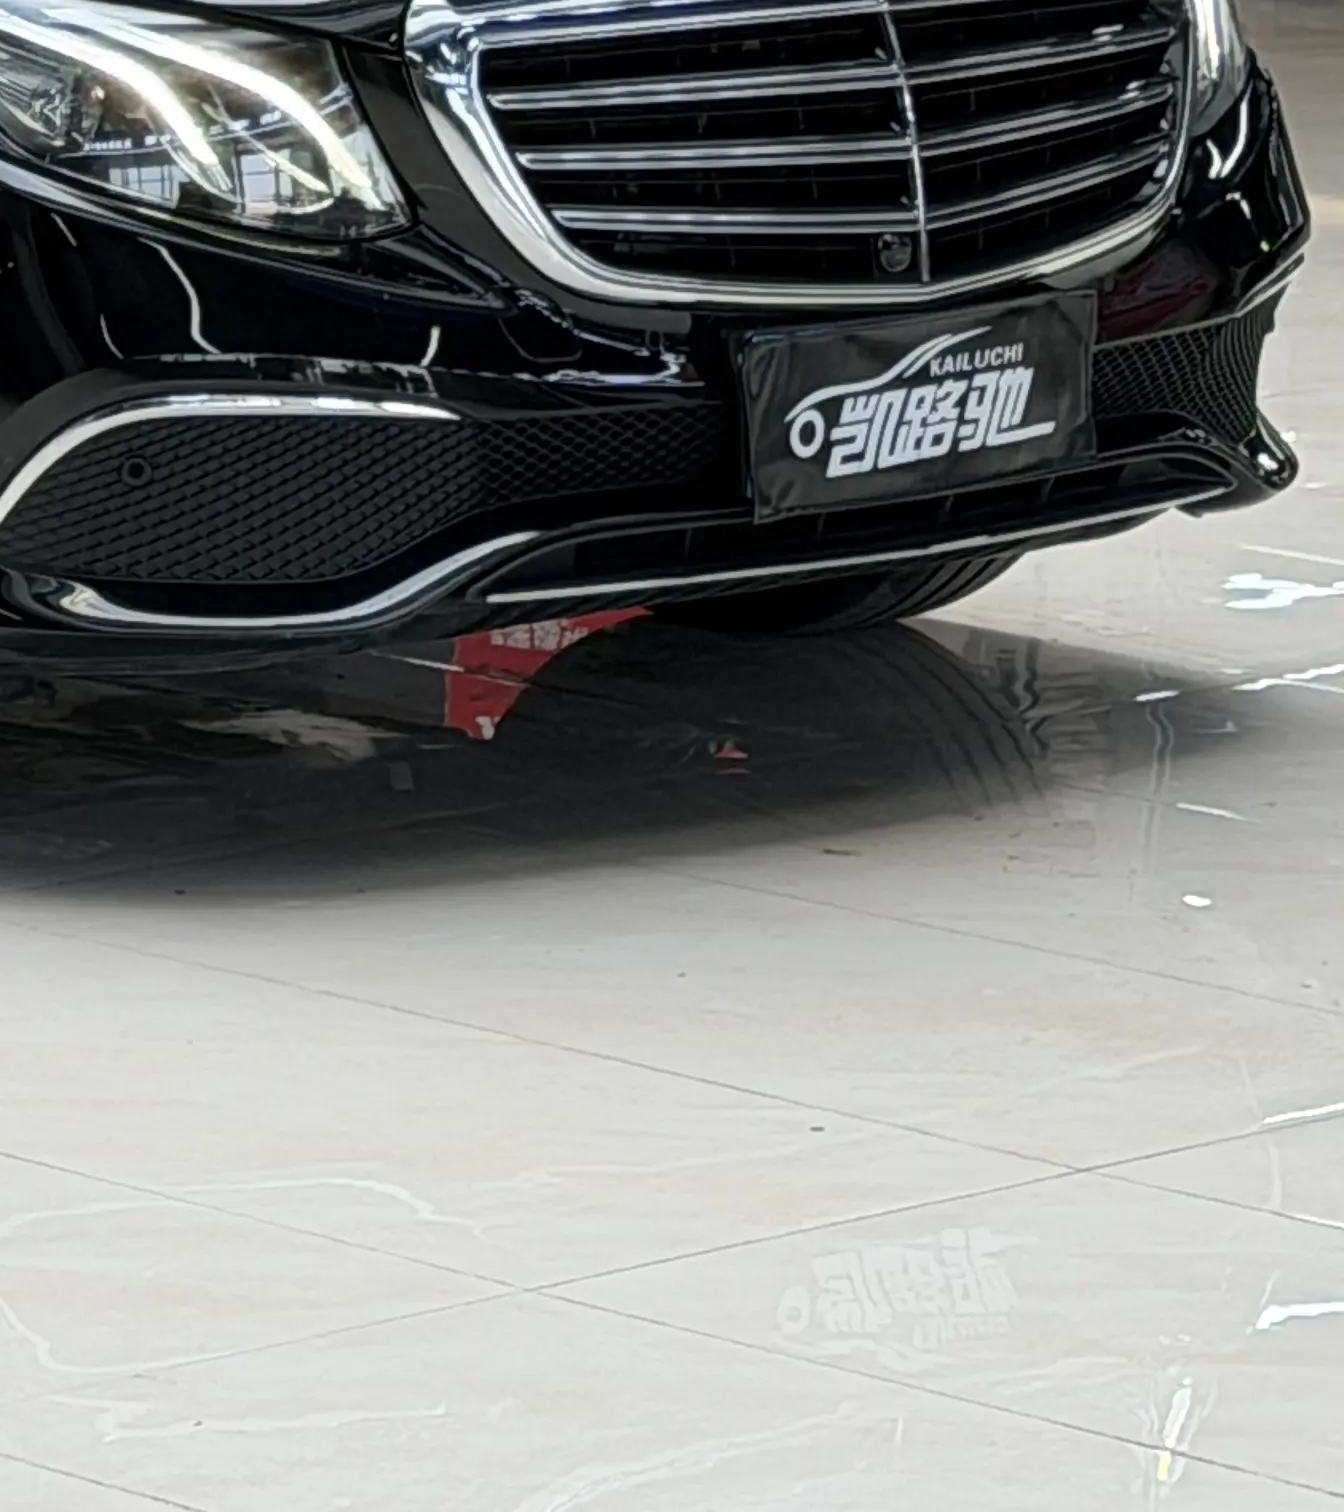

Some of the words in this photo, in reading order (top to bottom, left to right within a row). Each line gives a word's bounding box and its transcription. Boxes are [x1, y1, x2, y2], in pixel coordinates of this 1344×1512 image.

[929, 342, 1024, 378] KAILUCHI
[825, 366, 1057, 479] 凯路驰
